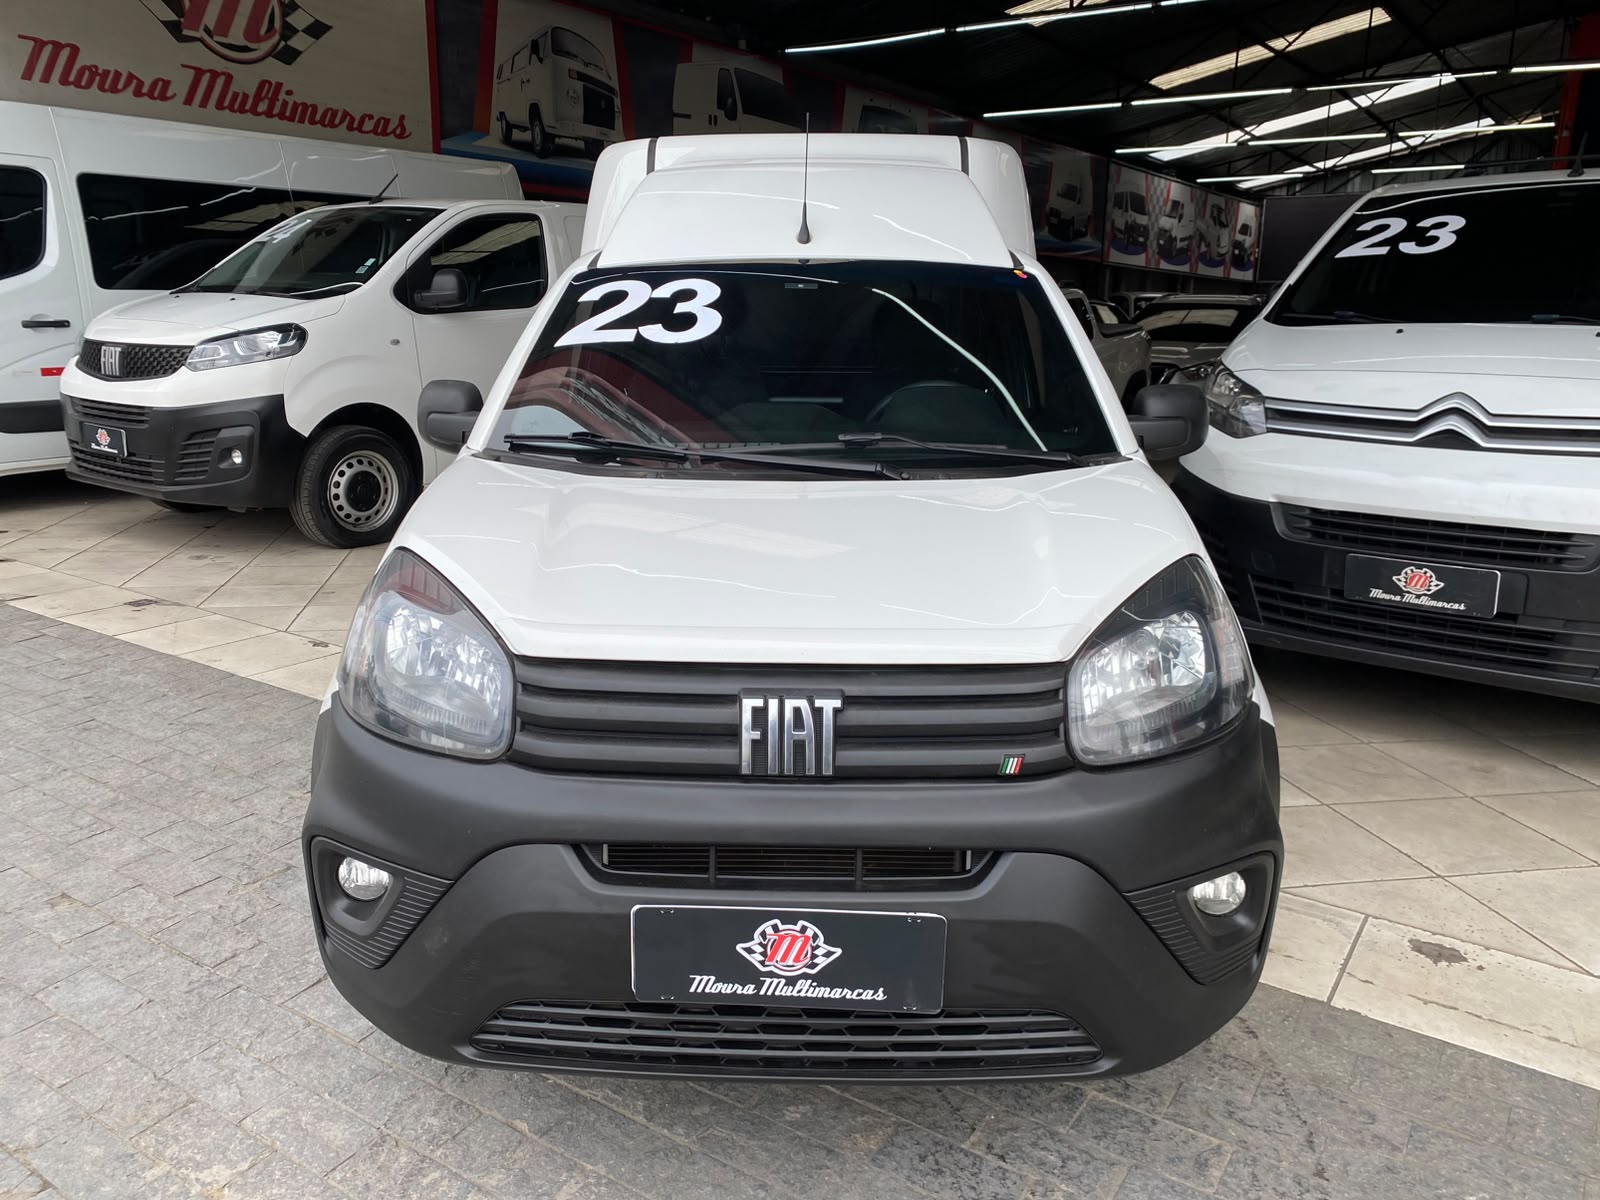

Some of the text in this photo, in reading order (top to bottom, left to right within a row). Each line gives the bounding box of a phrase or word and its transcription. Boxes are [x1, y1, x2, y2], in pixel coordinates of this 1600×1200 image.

[17, 34, 412, 139] Moura Multimarcas
[1334, 214, 1467, 259] 23
[553, 278, 723, 348] 23
[101, 345, 121, 376] FIAT
[1369, 588, 1467, 610] Moura Multimarcas
[739, 697, 844, 776] FIAT
[689, 975, 887, 1001] Moura Multimarcas
